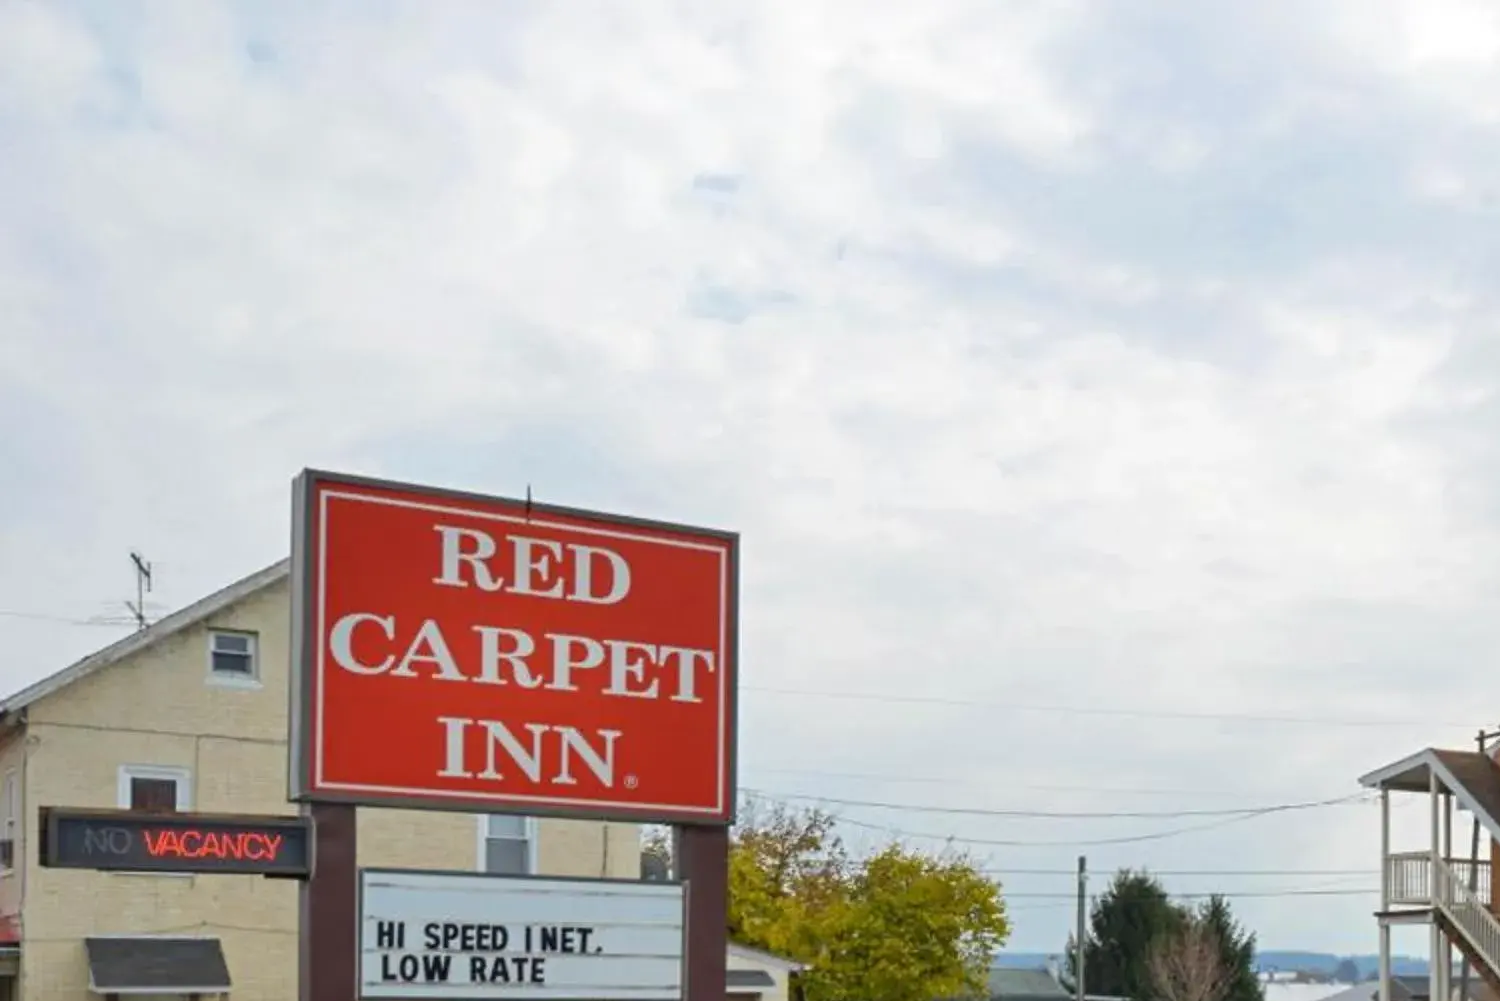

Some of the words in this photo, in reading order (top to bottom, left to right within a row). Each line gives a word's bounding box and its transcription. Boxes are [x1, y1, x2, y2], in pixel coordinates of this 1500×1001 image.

[432, 524, 631, 605] RED
[329, 612, 715, 704] CARPET
[436, 716, 623, 788] INN
[84, 828, 132, 854] NO
[143, 830, 283, 861] VACANCY
[377, 921, 405, 949] HI
[424, 923, 509, 951] SPEED
[381, 955, 452, 983] LOW
[470, 957, 546, 983] RATE
